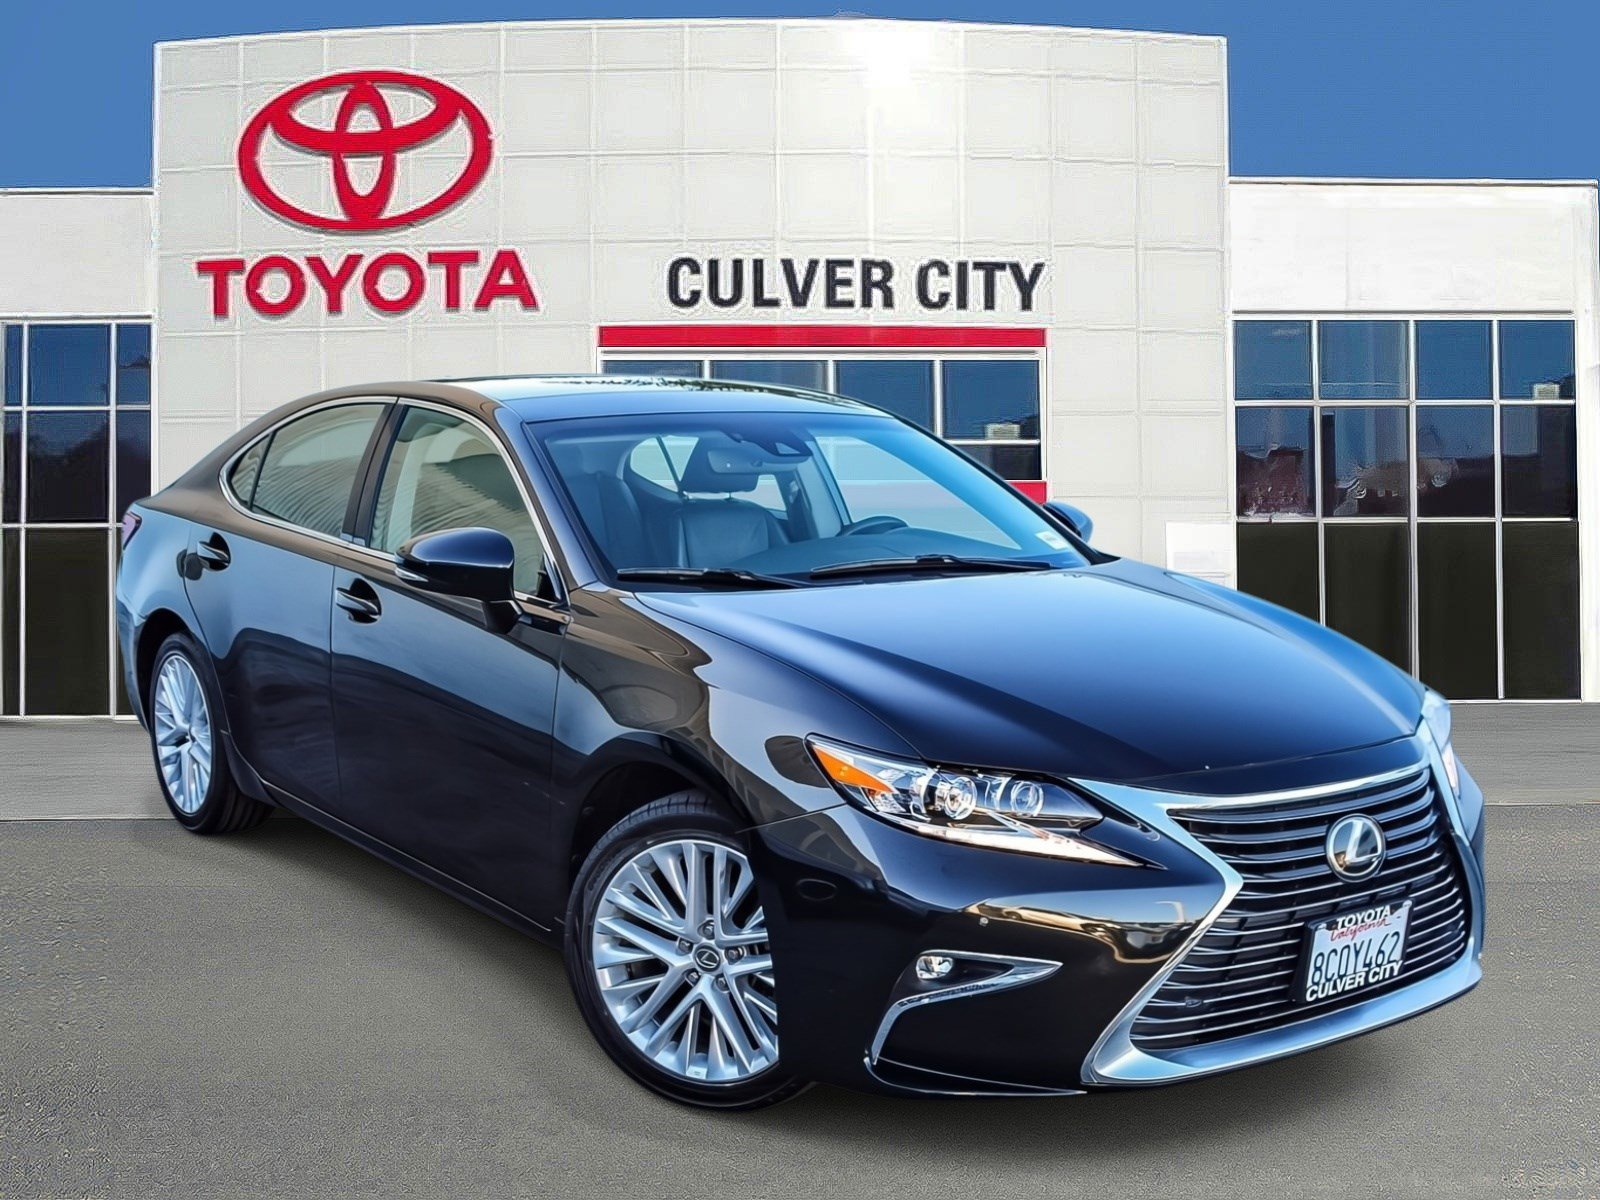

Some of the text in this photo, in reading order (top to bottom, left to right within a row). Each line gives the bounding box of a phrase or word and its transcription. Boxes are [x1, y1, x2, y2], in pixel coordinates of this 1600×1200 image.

[197, 249, 539, 318] TOYOTA
[667, 257, 1046, 311] CULVER CITY
[1337, 905, 1391, 929] TOYOTA
[1305, 960, 1403, 1001] CULVER CITY
